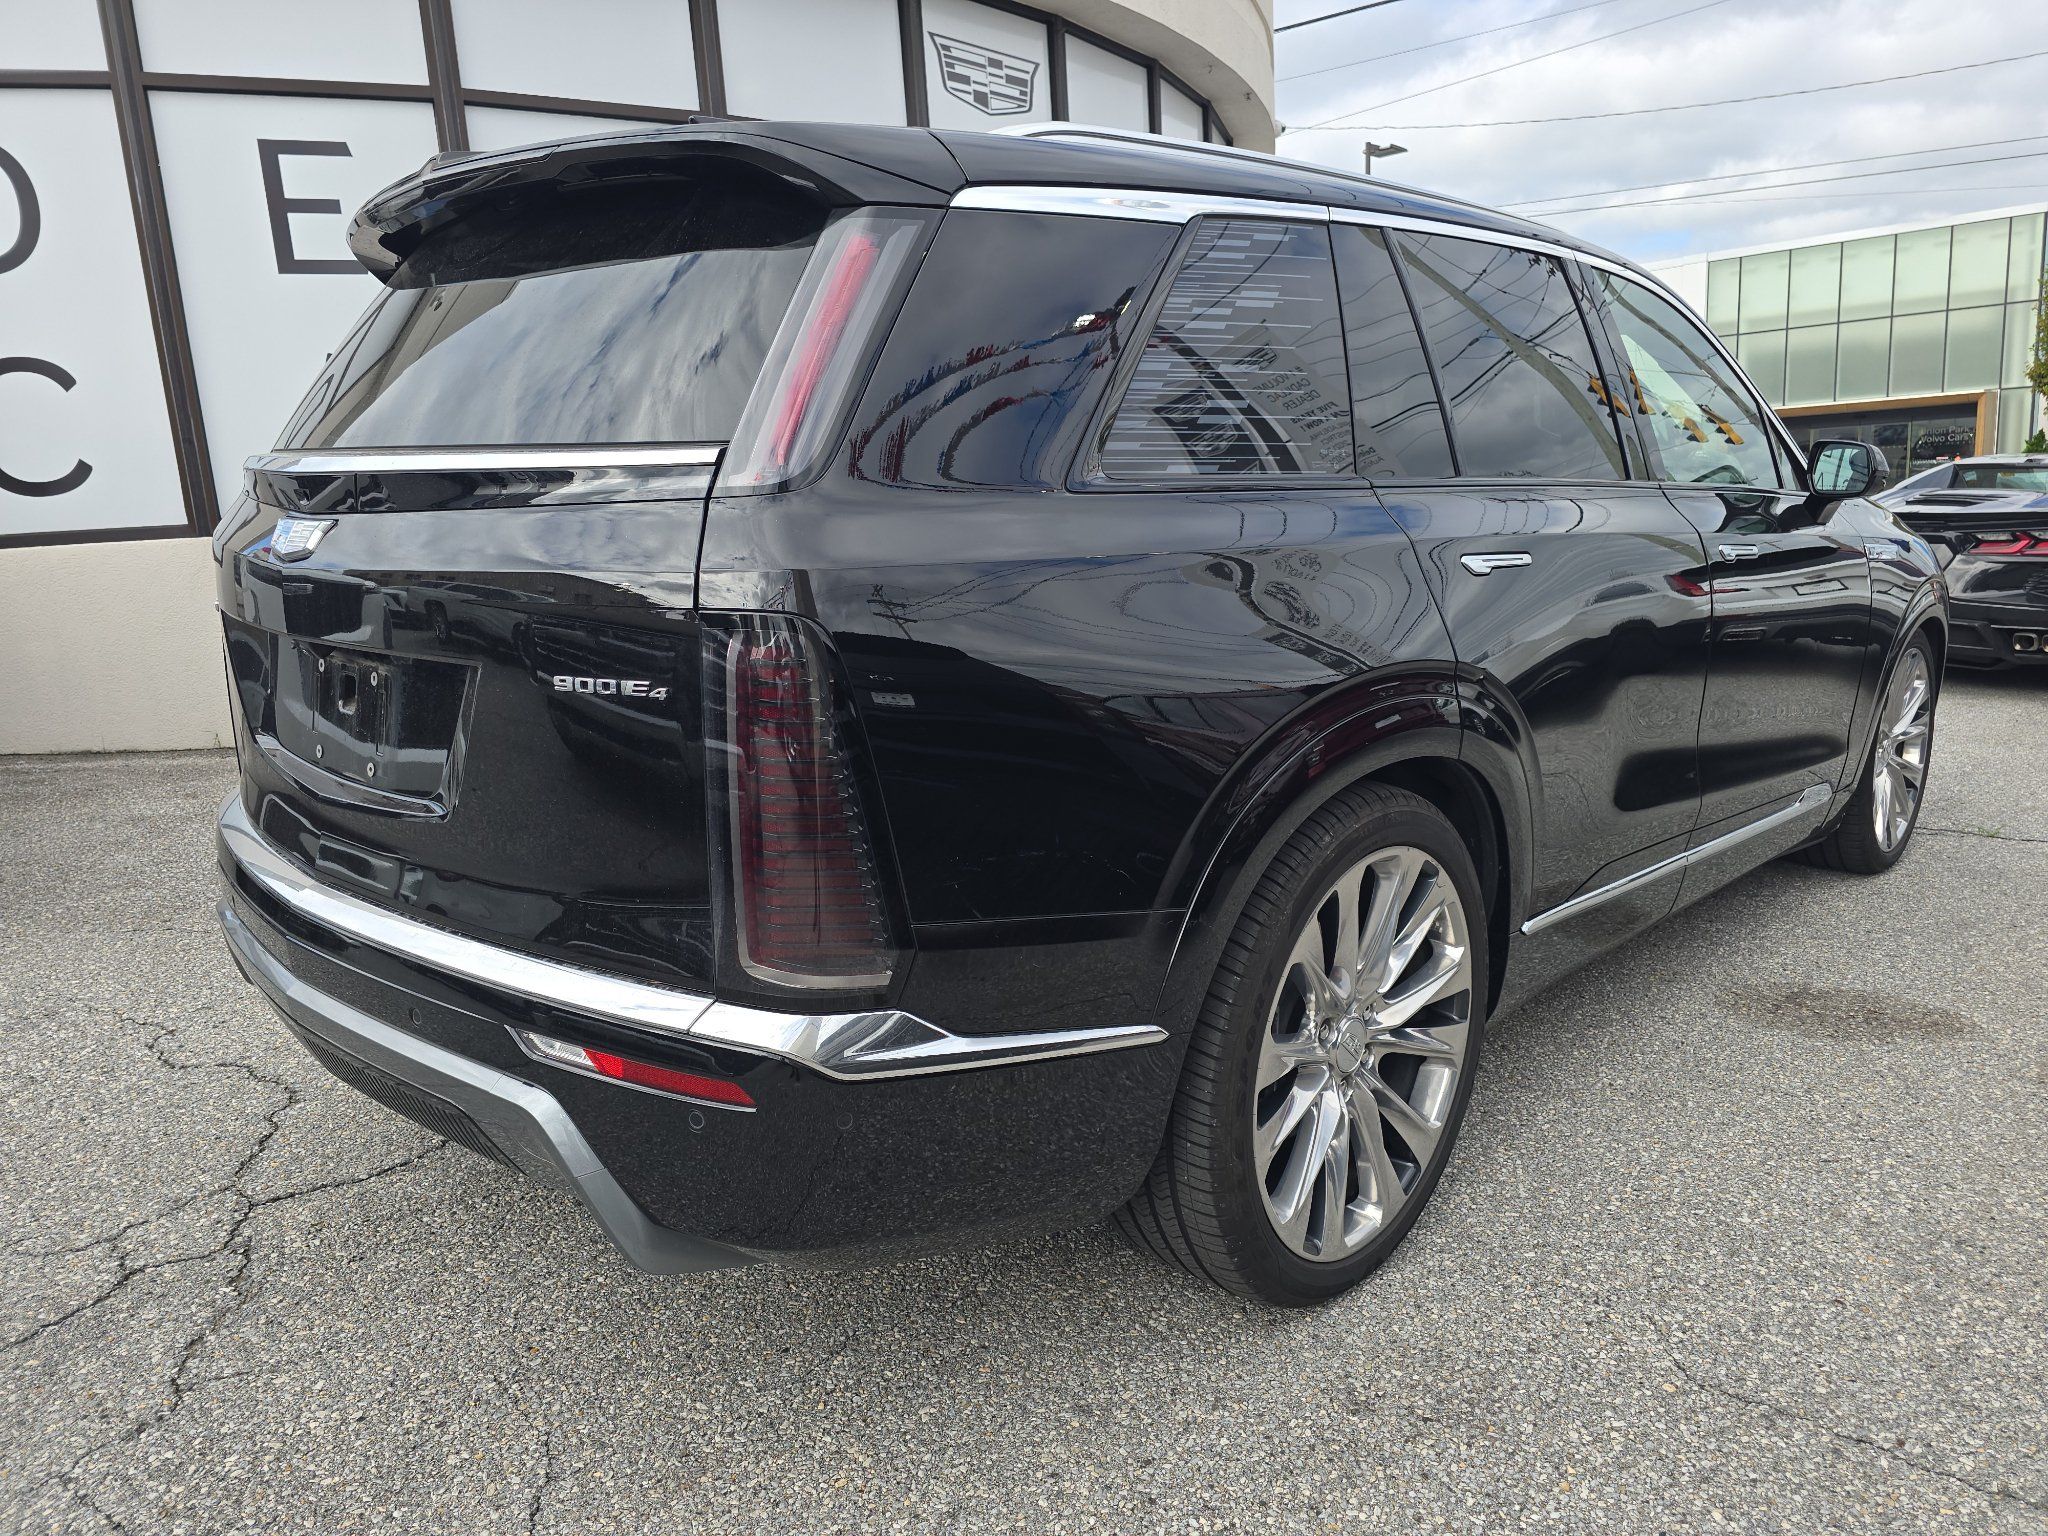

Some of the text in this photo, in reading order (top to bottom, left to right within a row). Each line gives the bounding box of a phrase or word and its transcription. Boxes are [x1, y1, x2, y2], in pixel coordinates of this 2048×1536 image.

[1949, 424, 1970, 433] Park
[1920, 432, 1969, 443] Volvo Cars
